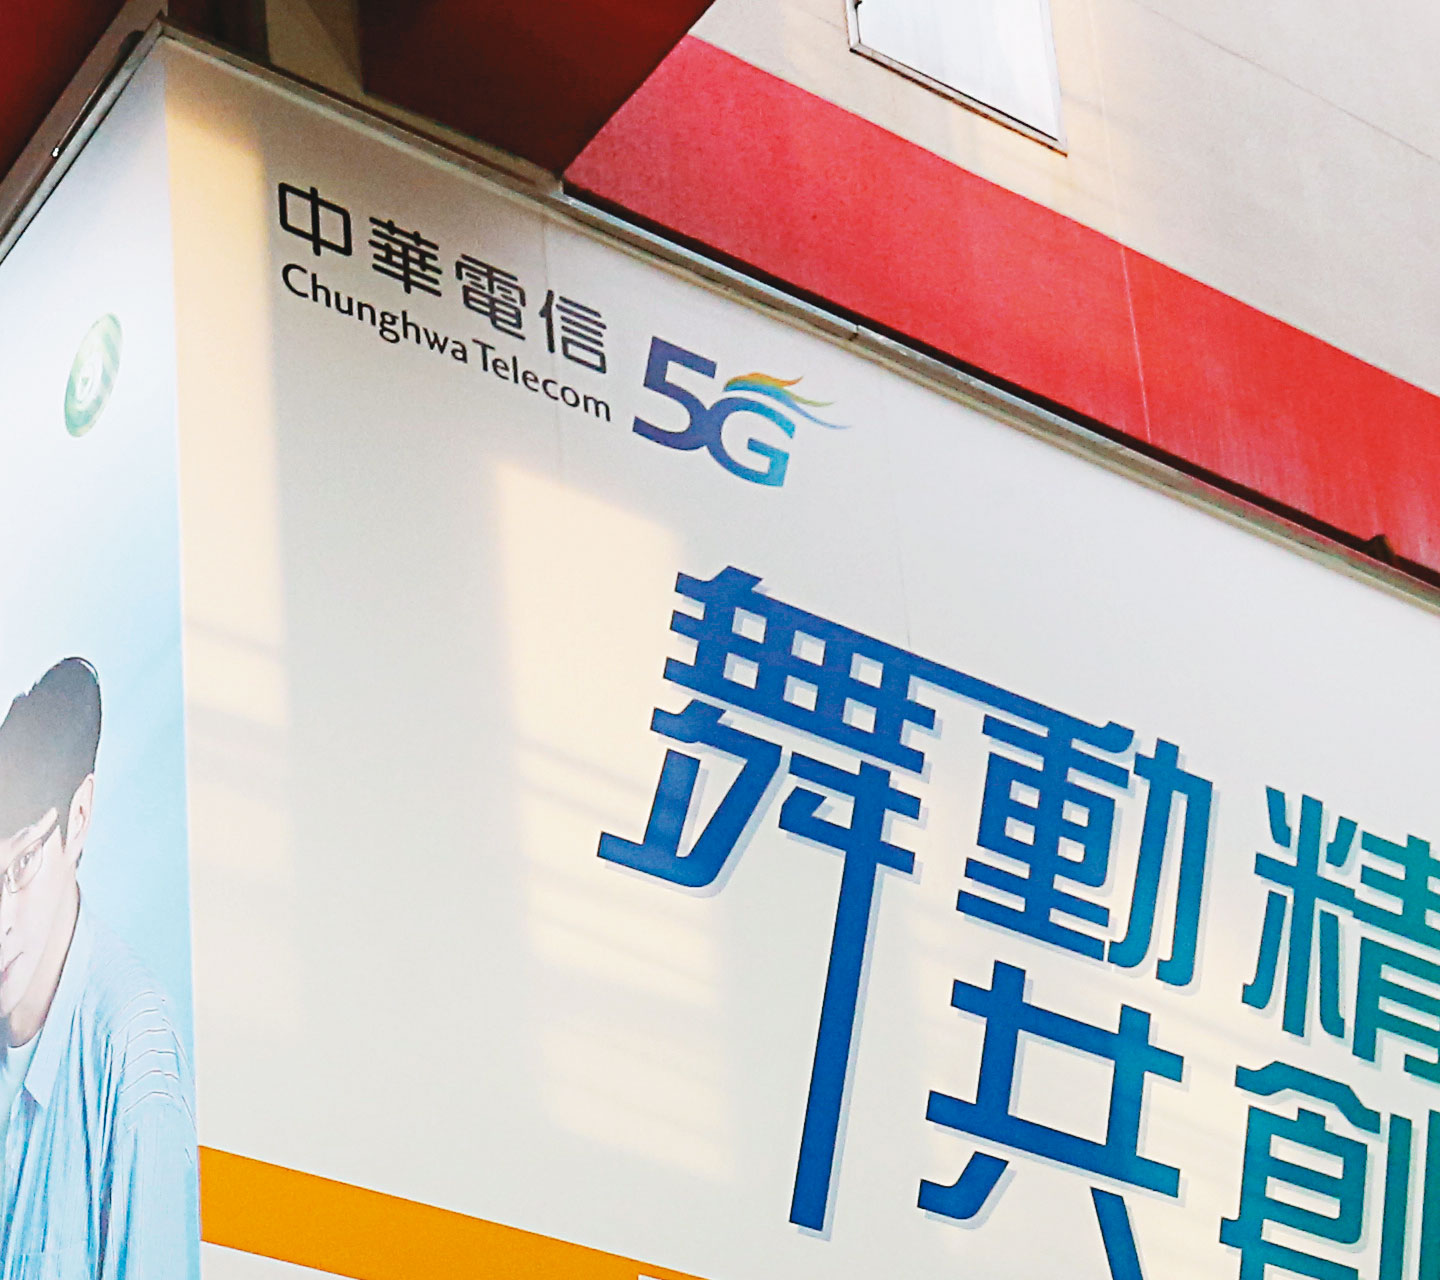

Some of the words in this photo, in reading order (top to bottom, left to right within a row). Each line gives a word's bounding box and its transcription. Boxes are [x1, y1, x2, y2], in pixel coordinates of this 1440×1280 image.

[278, 182, 607, 374] 中華電信
[282, 263, 467, 368] Chunghwa
[473, 338, 611, 423] Telecom
[632, 336, 797, 488] 5G
